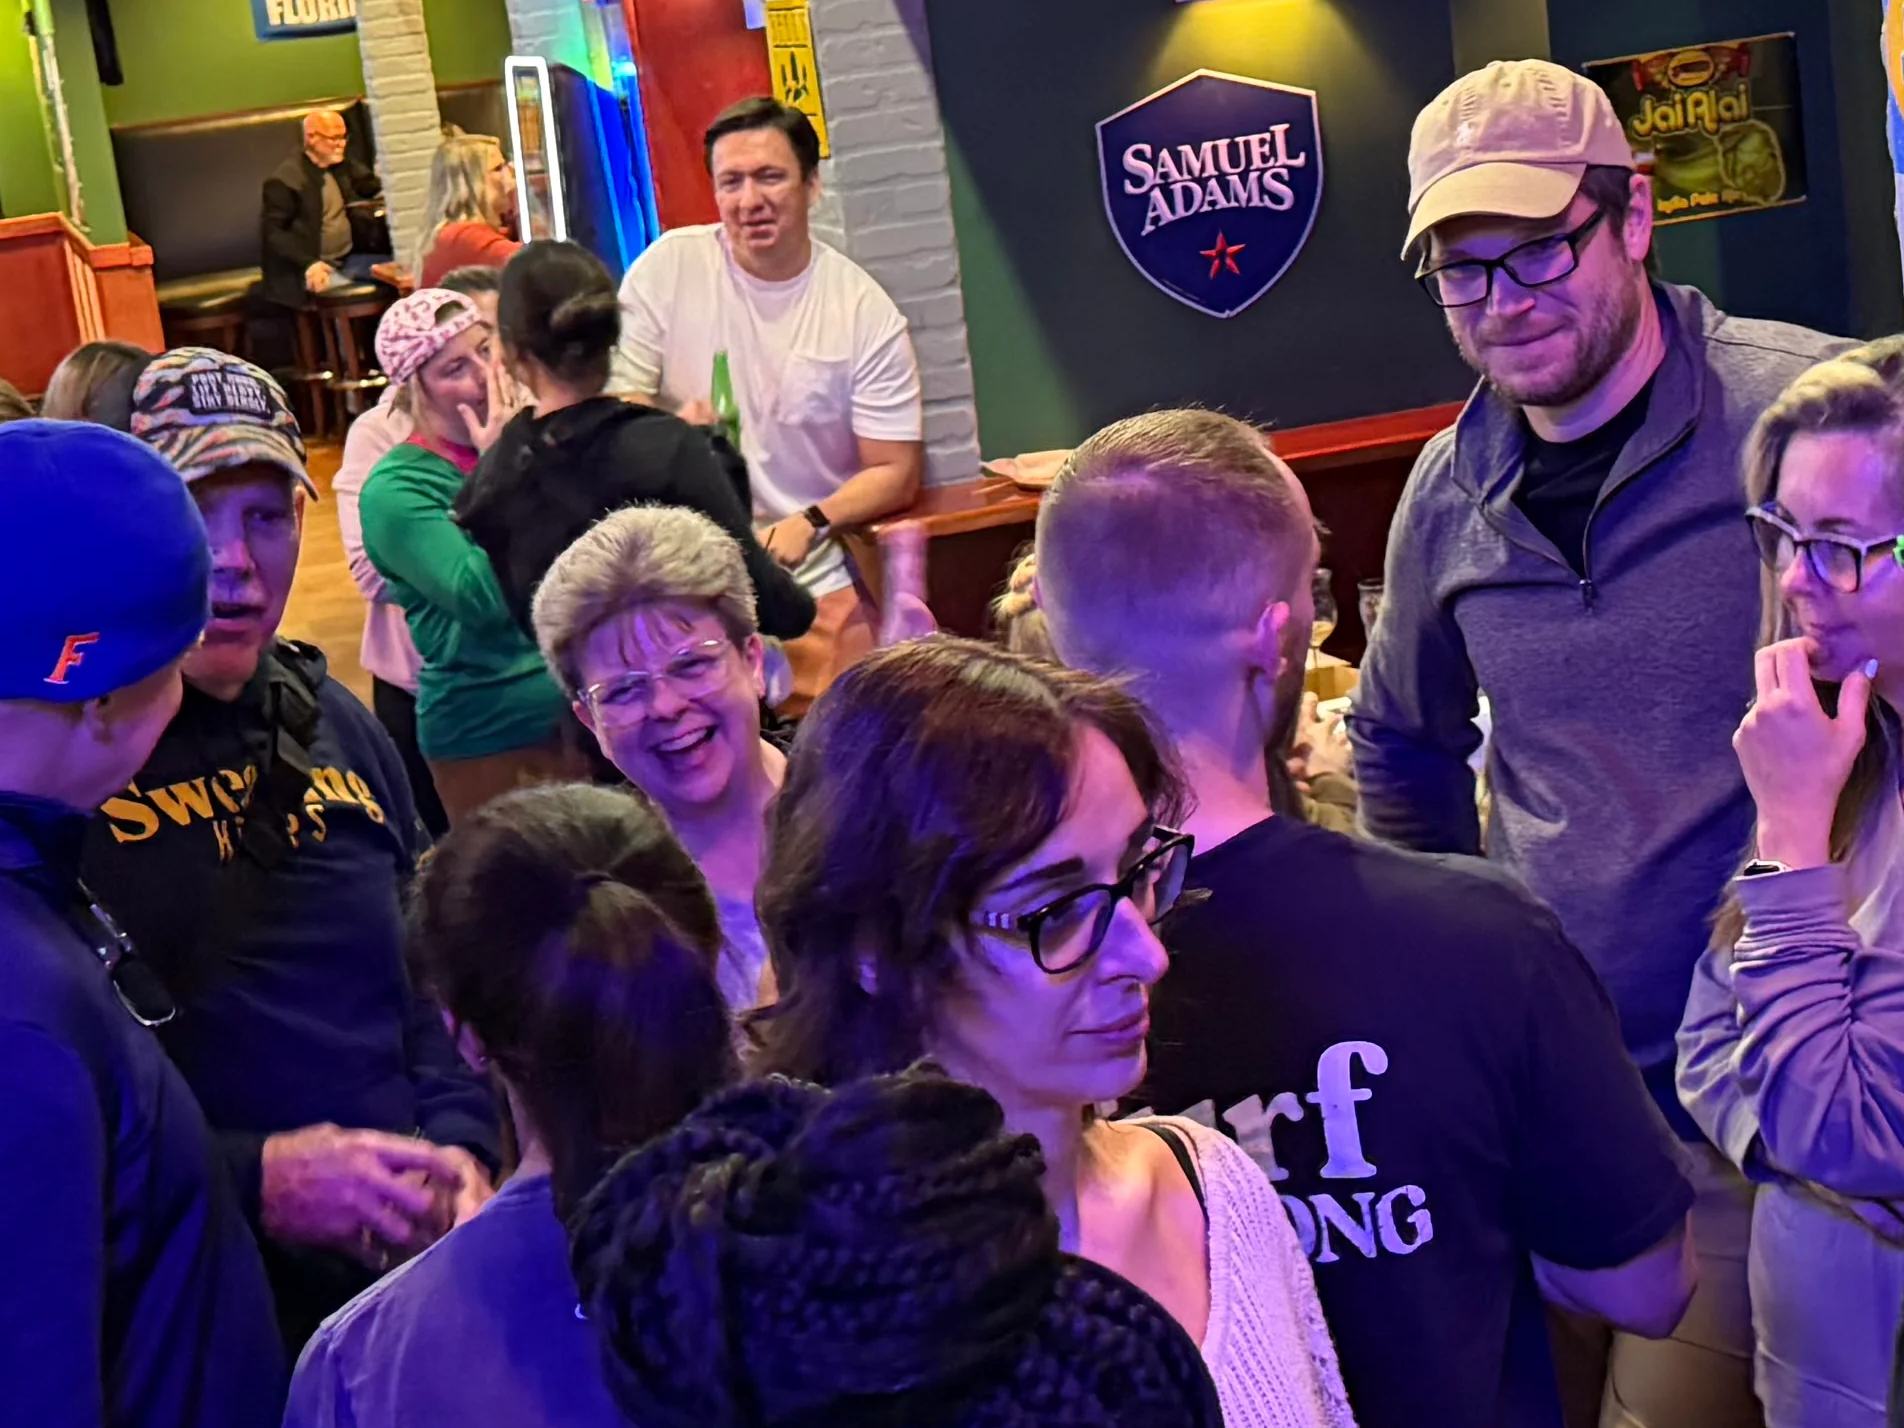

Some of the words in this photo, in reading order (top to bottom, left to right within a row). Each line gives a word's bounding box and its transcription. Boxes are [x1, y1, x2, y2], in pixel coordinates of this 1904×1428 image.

[1632, 91, 1684, 136] Jai
[1686, 80, 1747, 134] Alai
[1121, 123, 1306, 196] SAMUEL
[1139, 167, 1295, 237] ADAMS
[43, 631, 100, 685] F
